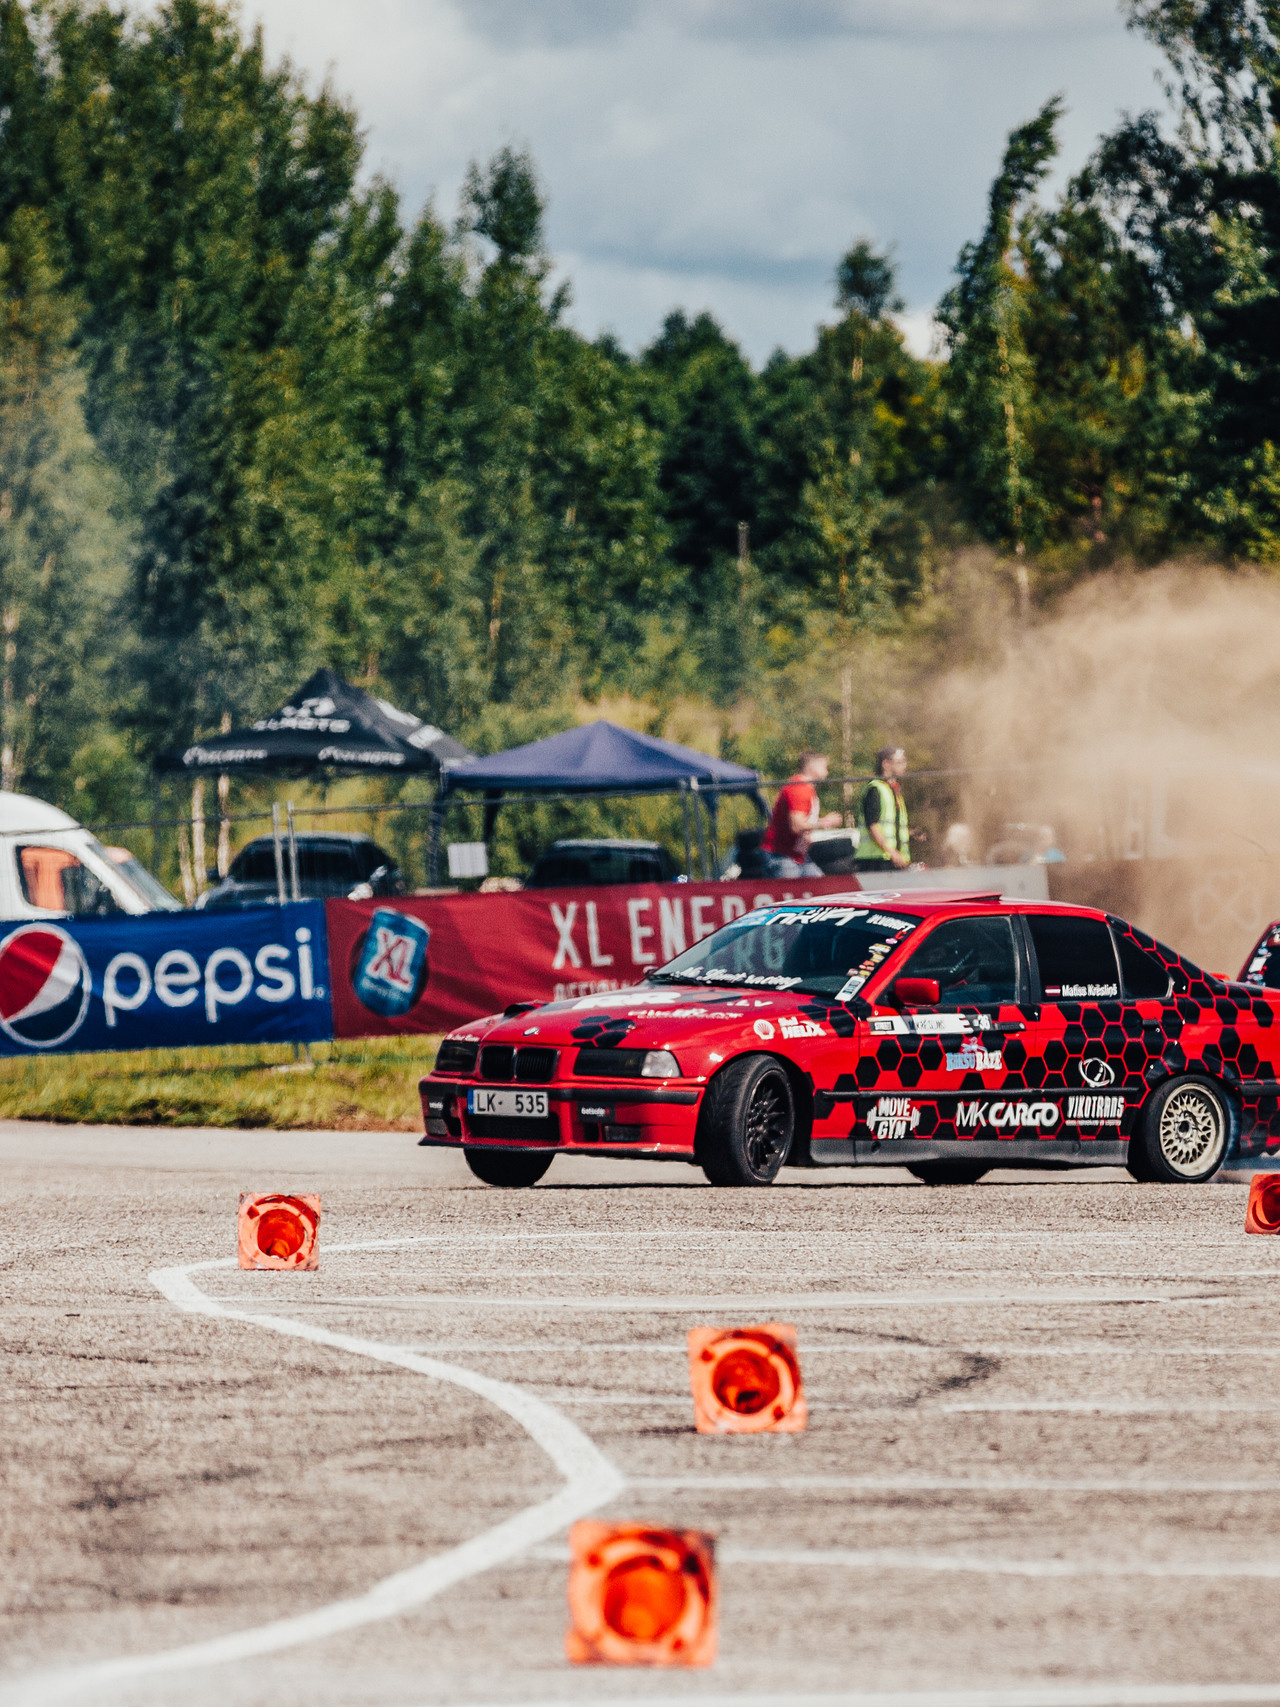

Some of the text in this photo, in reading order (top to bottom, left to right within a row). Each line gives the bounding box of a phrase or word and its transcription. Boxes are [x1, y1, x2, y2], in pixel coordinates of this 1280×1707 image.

[550, 901, 614, 970] XL
[365, 926, 418, 993] XL
[102, 927, 315, 1028] pepsi
[781, 1021, 827, 1039] HELIX
[515, 1094, 545, 1114] 535
[878, 1097, 911, 1116] MOVE
[877, 1119, 907, 1139] GYM
